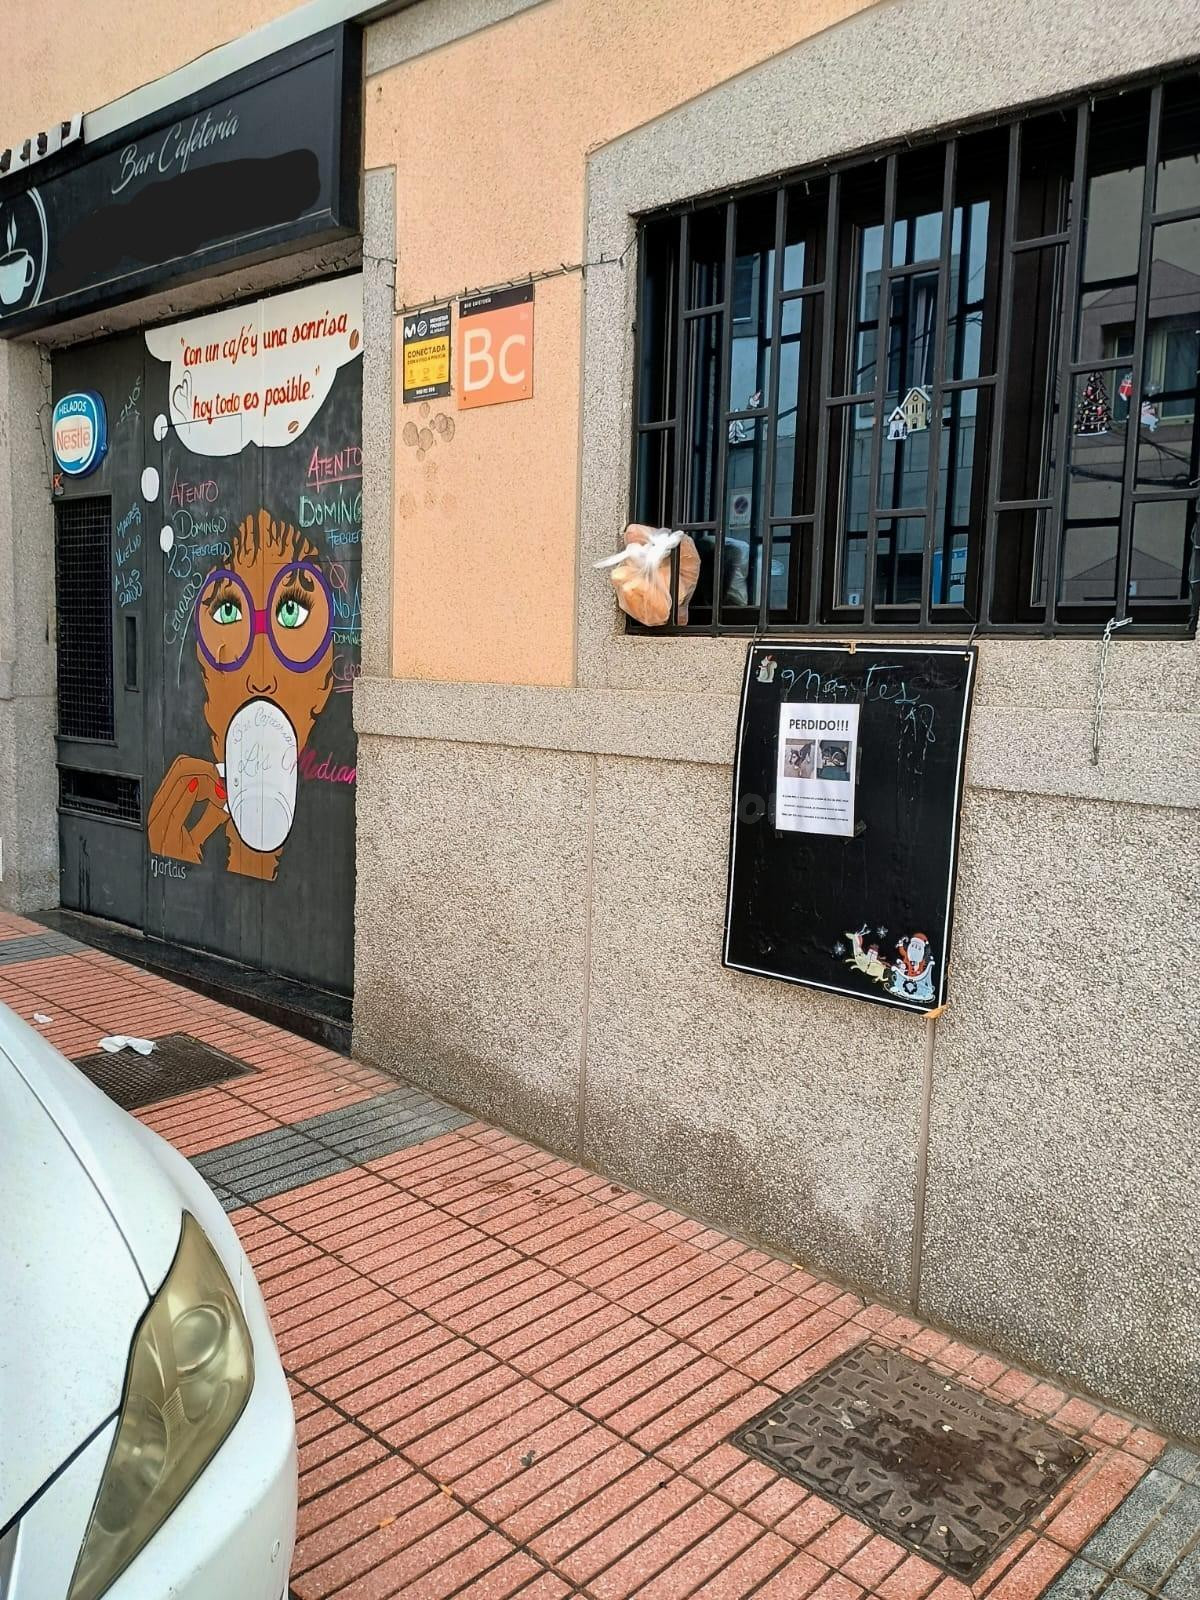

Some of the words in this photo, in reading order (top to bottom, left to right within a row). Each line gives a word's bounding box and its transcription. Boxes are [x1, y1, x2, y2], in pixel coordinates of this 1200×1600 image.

[112, 144, 156, 194] Bar
[159, 109, 240, 174] Cafetería
[205, 344, 219, 361] un
[222, 324, 253, 364] café
[250, 333, 258, 356] y
[263, 328, 287, 349] una
[292, 310, 348, 343] sonrisa
[407, 344, 446, 359] CONECTADA
[58, 400, 87, 415] HELADOS
[193, 396, 212, 421] hoy
[215, 393, 239, 415] todo
[244, 392, 259, 411] es
[170, 467, 219, 505] ATENTO
[332, 588, 350, 619] NO
[789, 718, 849, 732] PERDIDO!!!
